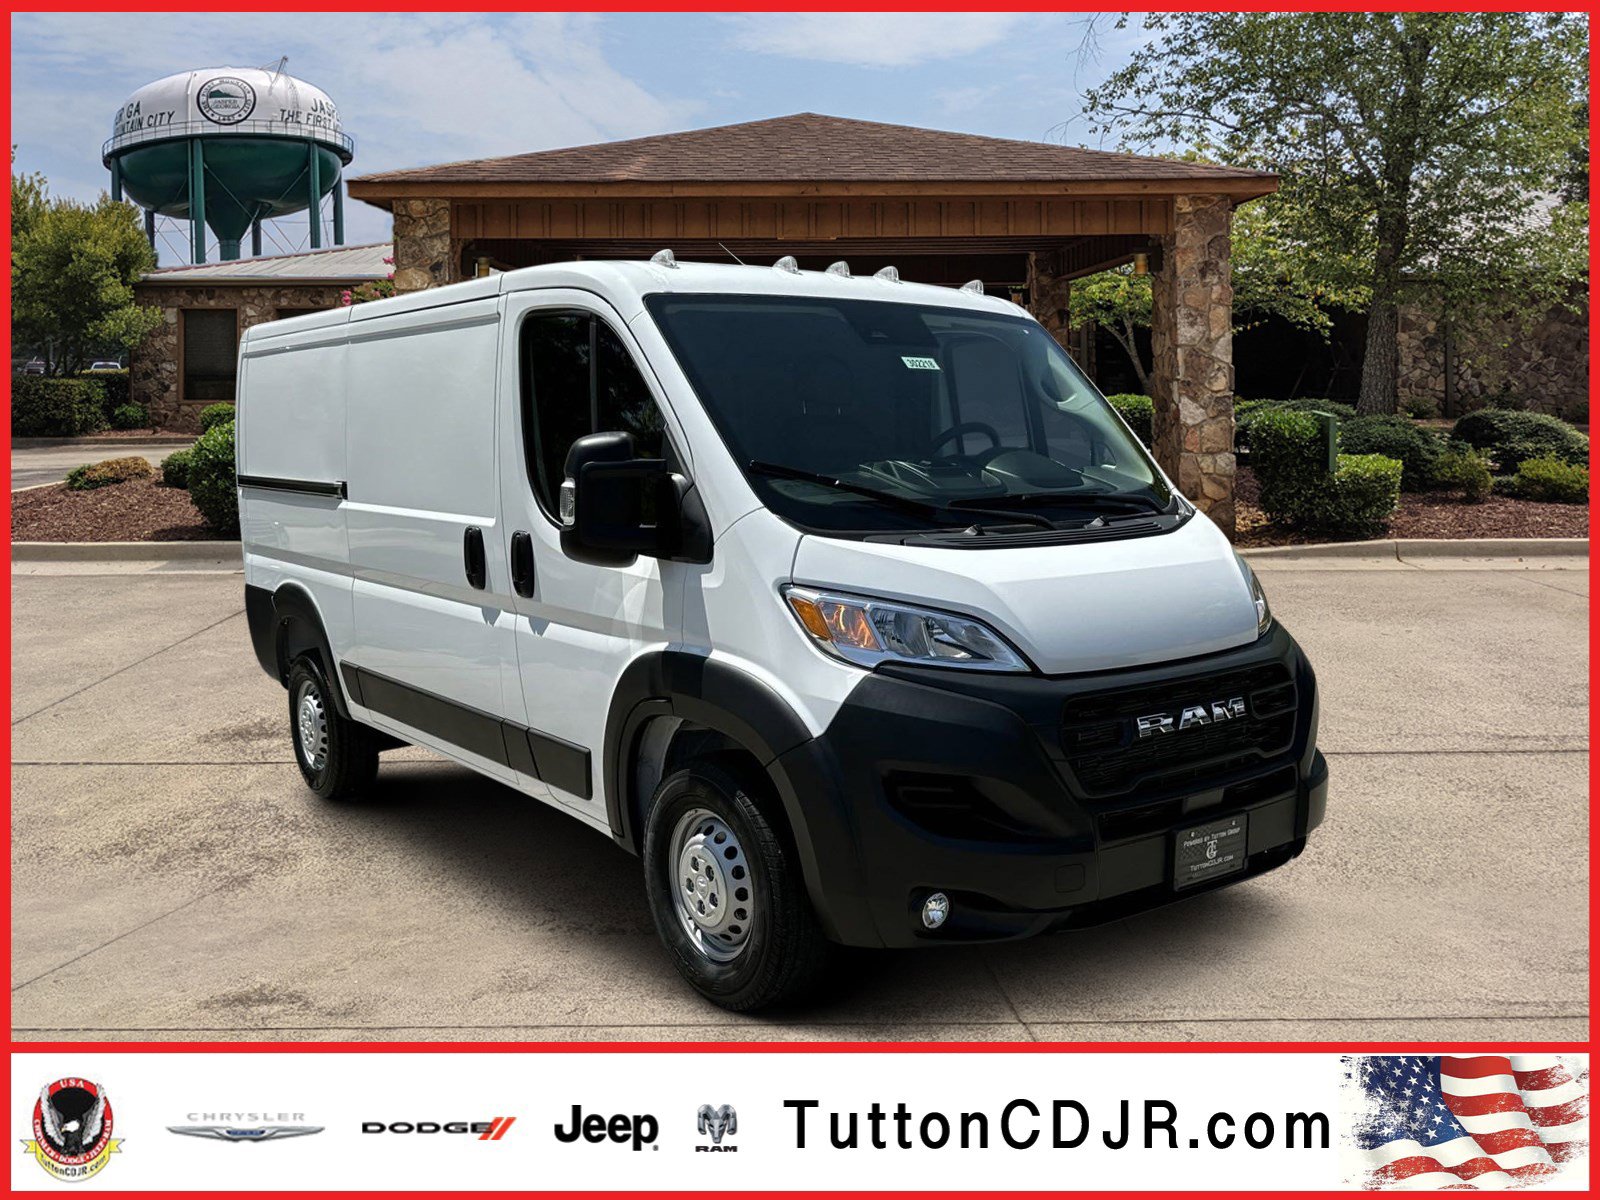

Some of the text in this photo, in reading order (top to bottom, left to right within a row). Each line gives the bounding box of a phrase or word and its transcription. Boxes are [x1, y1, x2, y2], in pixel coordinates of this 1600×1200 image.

[126, 100, 141, 119] GA
[147, 111, 175, 127] CITY
[280, 108, 302, 123] THE
[306, 112, 332, 129] FIRST
[1137, 697, 1247, 738] RAM
